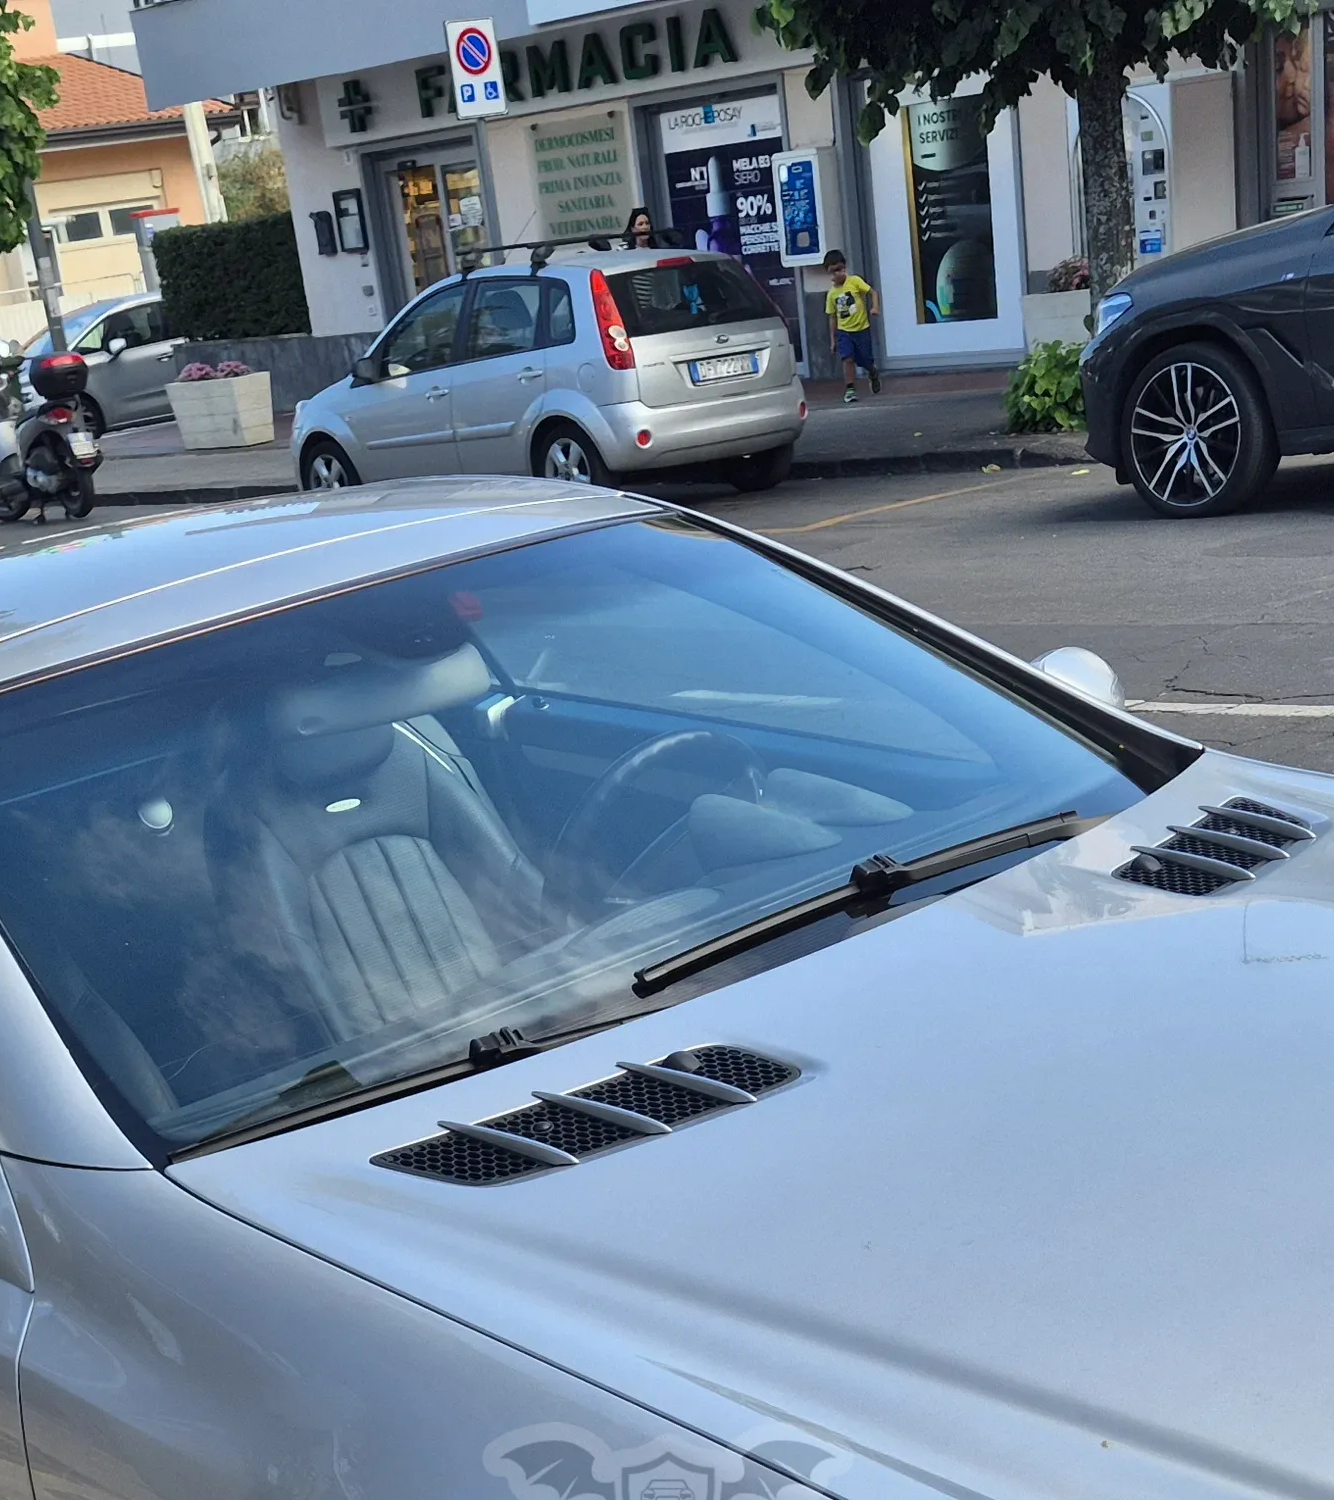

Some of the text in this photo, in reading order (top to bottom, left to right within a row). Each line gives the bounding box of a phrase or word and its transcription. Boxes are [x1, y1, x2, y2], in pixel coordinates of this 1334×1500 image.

[415, 9, 738, 118] FRMACIA
[534, 127, 614, 152] DERMOCOSMESI
[558, 194, 615, 213] SANITARIA
[736, 193, 772, 218] 90%
[549, 215, 621, 235] VETERINARIA
